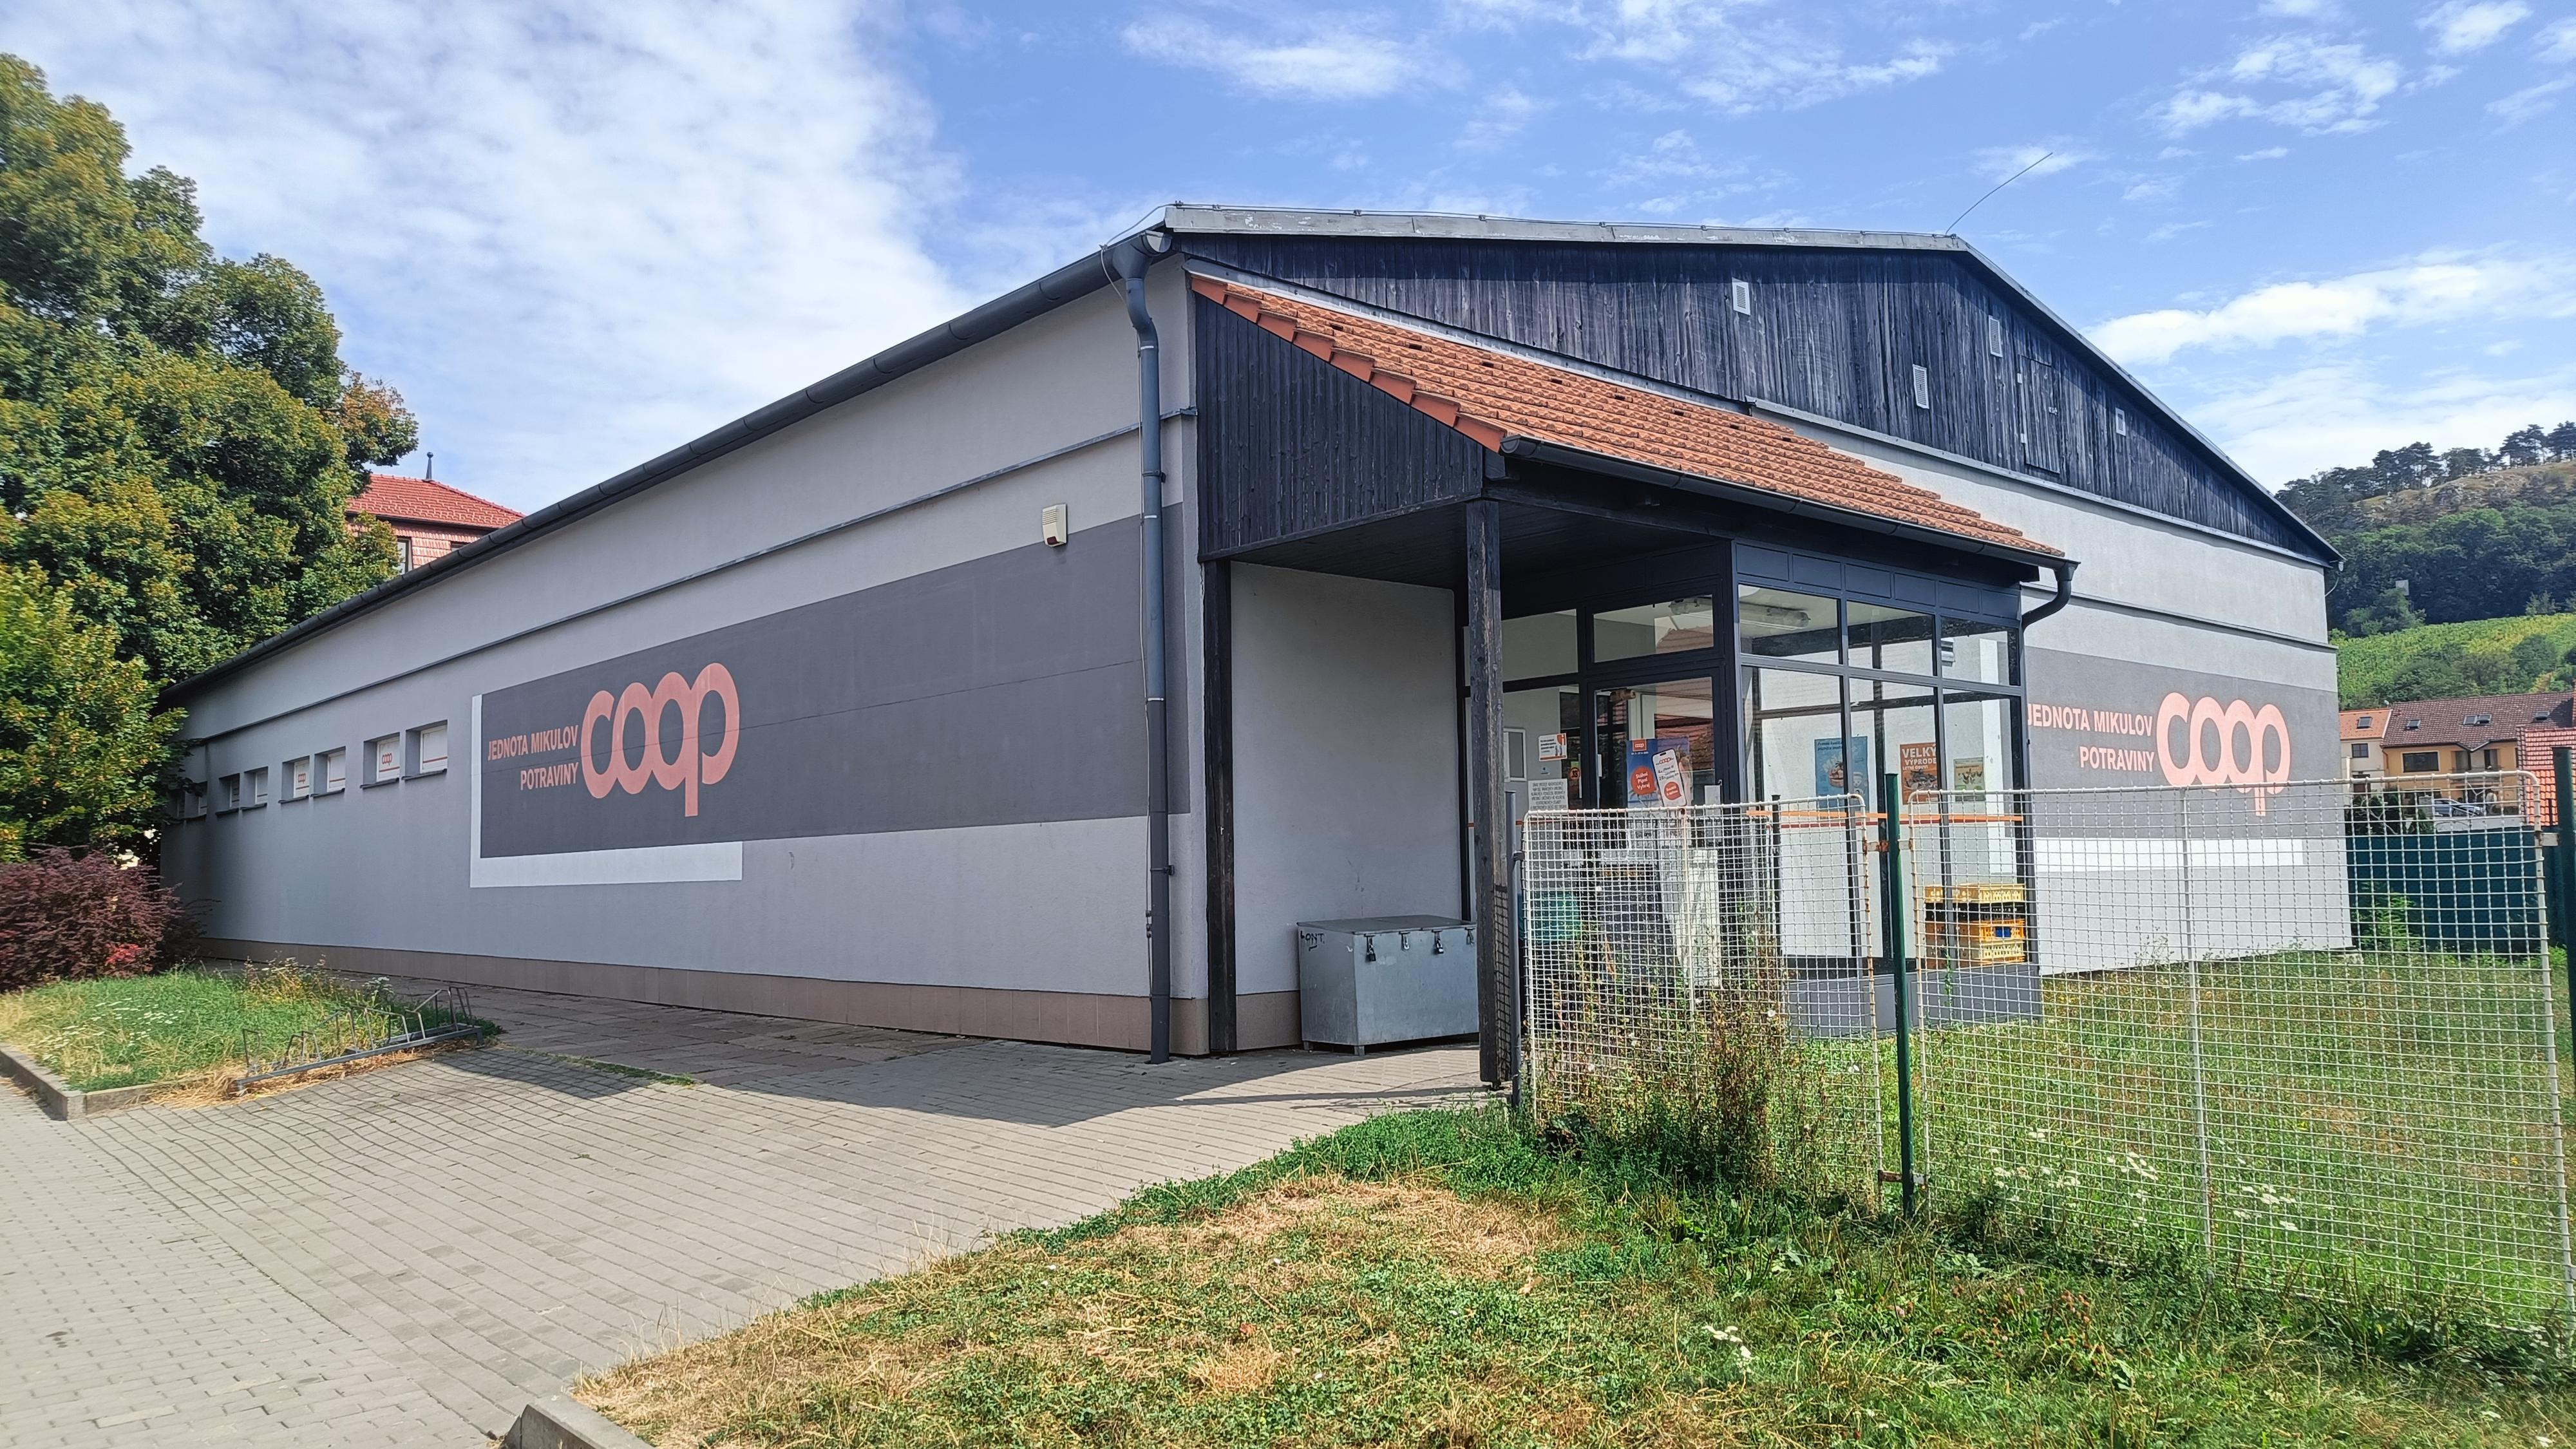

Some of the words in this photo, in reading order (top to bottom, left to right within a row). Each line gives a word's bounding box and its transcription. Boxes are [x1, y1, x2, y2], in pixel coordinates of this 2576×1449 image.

[2027, 703, 2090, 732] JEDNOTA
[2094, 710, 2153, 737] MIKULOV
[488, 734, 528, 761] JEDNOTA
[531, 725, 578, 755] MIKULOV
[1902, 744, 1936, 758] VELKÝ
[1905, 757, 1937, 766] VÝPRODE
[2079, 746, 2155, 772] POTRAVINY
[520, 762, 579, 790] POTRAVINY
